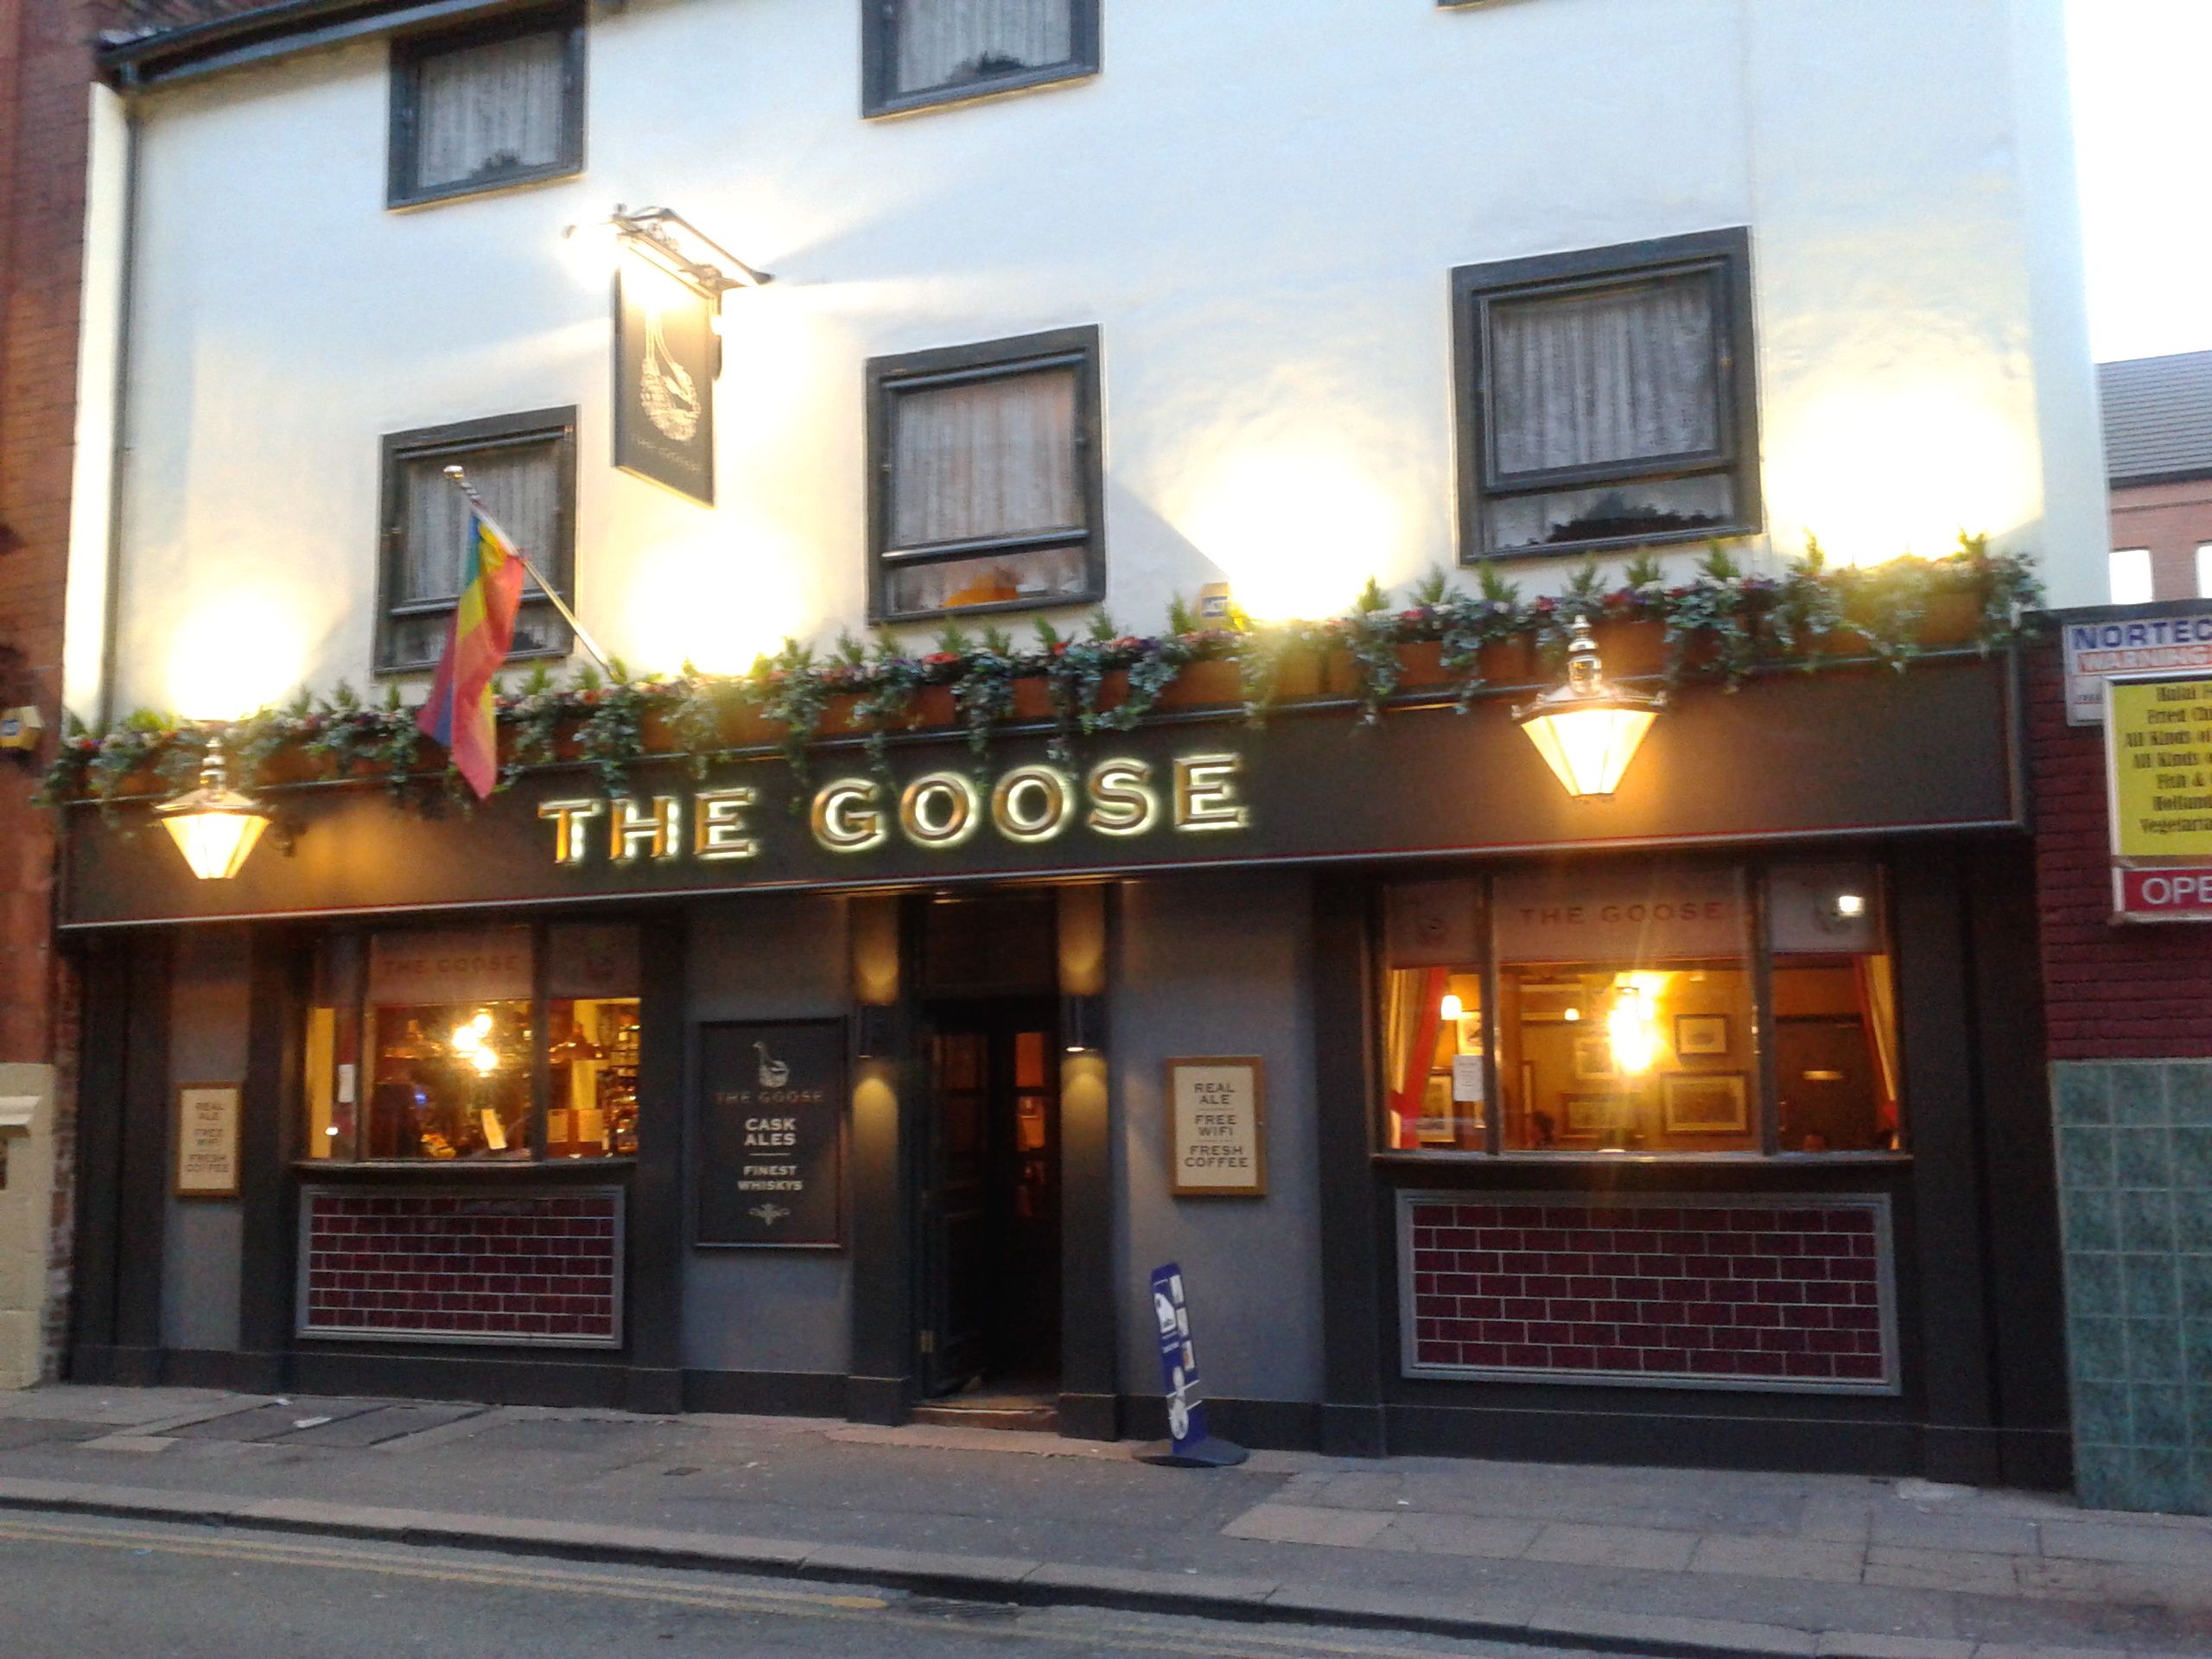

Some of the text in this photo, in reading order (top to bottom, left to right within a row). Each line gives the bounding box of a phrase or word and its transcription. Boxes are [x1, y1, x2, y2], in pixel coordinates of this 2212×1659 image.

[537, 750, 1249, 865] THE GOOSE
[1518, 901, 1723, 926] THE GOOSE
[1194, 1083, 1236, 1093] REAL
[757, 1090, 824, 1103] GOOSE
[1199, 1094, 1230, 1105] ALE
[744, 1117, 798, 1131] CASK
[1196, 1115, 1237, 1125] FREE
[1198, 1127, 1234, 1137] WIFI
[743, 1133, 798, 1147] ALES
[1189, 1145, 1243, 1155] FRESH
[1184, 1157, 1249, 1167] COFFEE
[742, 1166, 798, 1176] FINEST
[736, 1179, 804, 1192] WHISKYS
